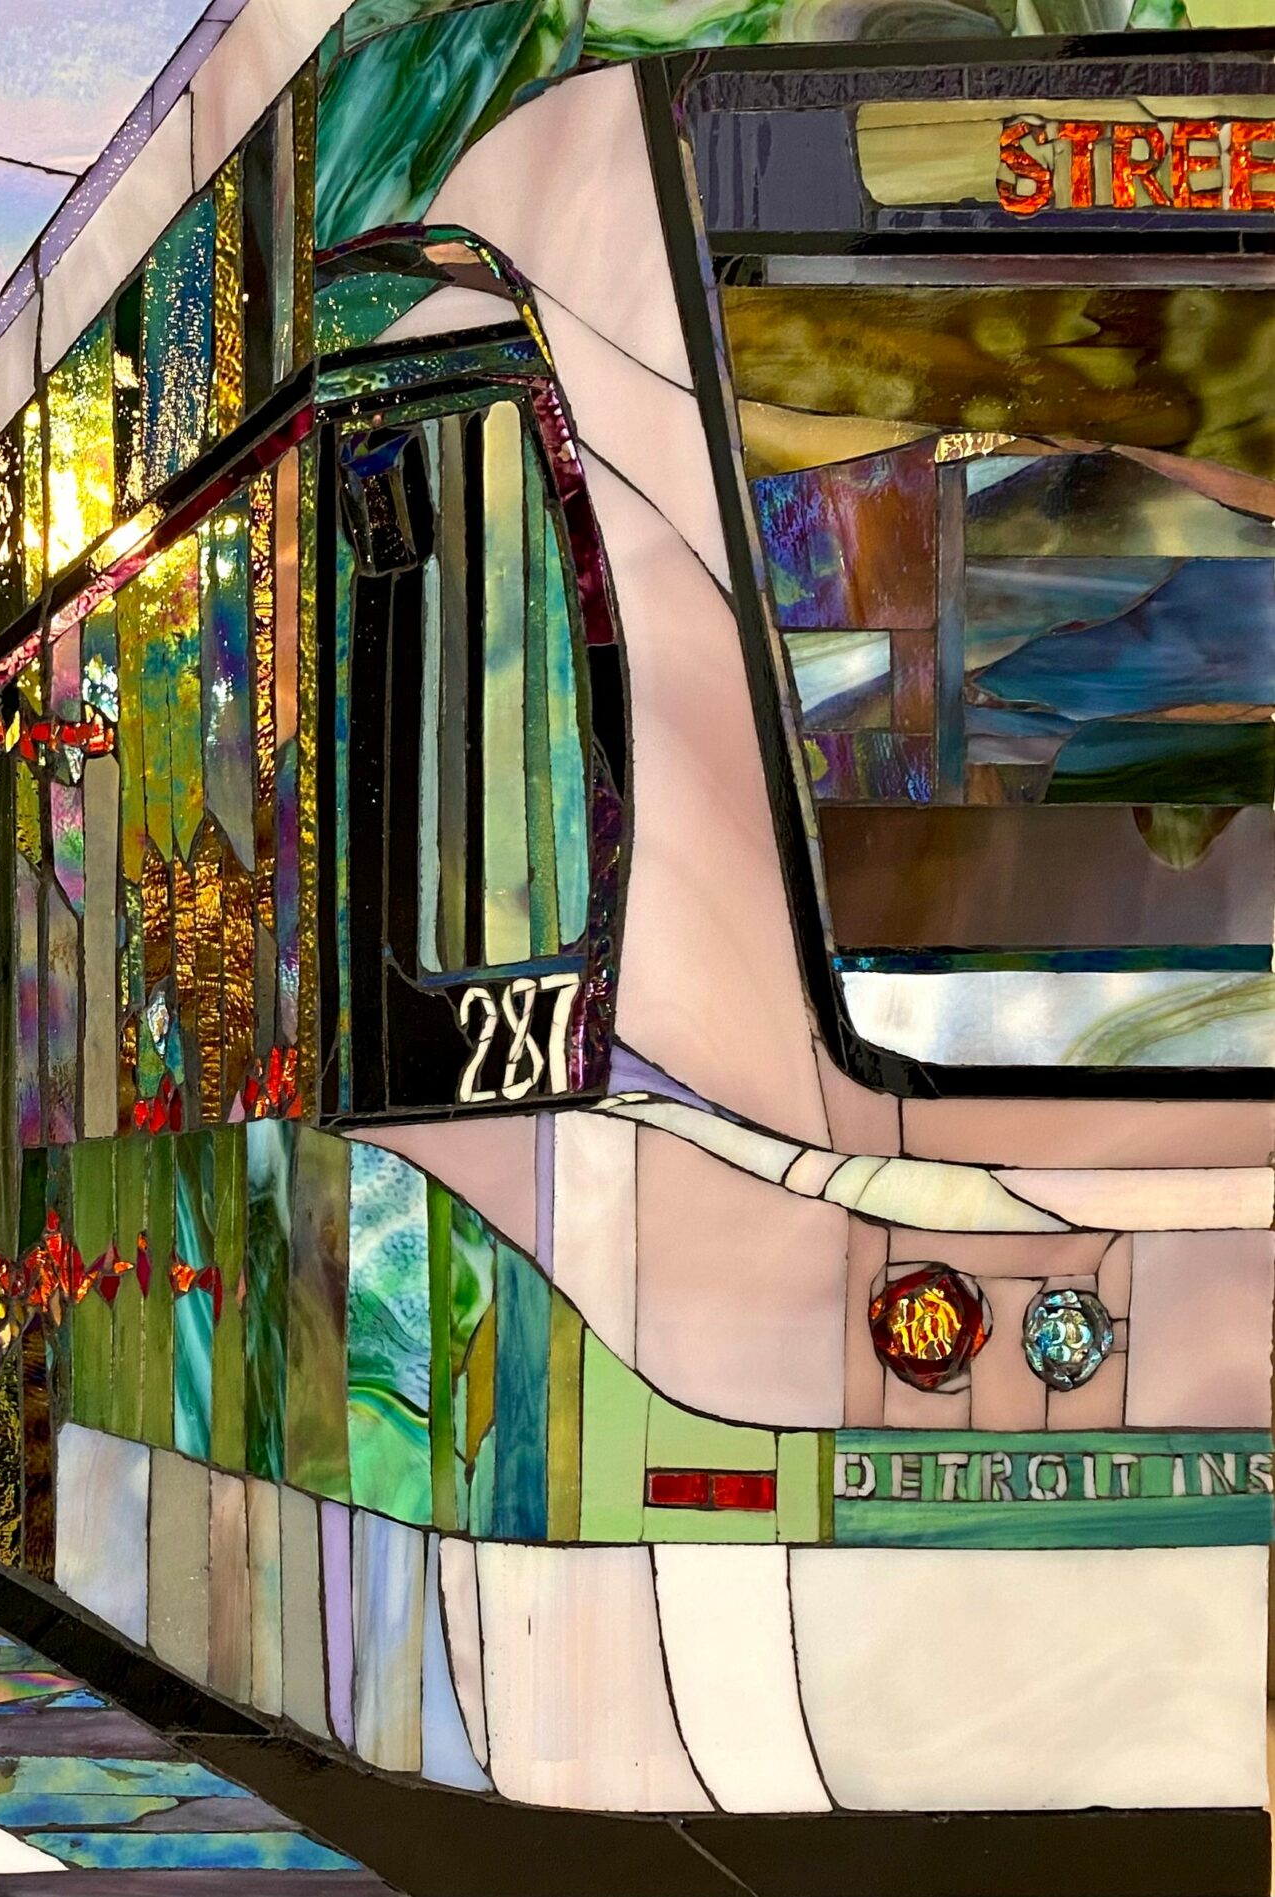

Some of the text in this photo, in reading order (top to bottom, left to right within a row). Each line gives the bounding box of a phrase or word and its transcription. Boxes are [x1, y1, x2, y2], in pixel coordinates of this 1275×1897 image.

[996, 120, 1275, 214] STREE
[459, 973, 580, 1102] 287
[833, 1452, 1274, 1500] DETROIT INS
